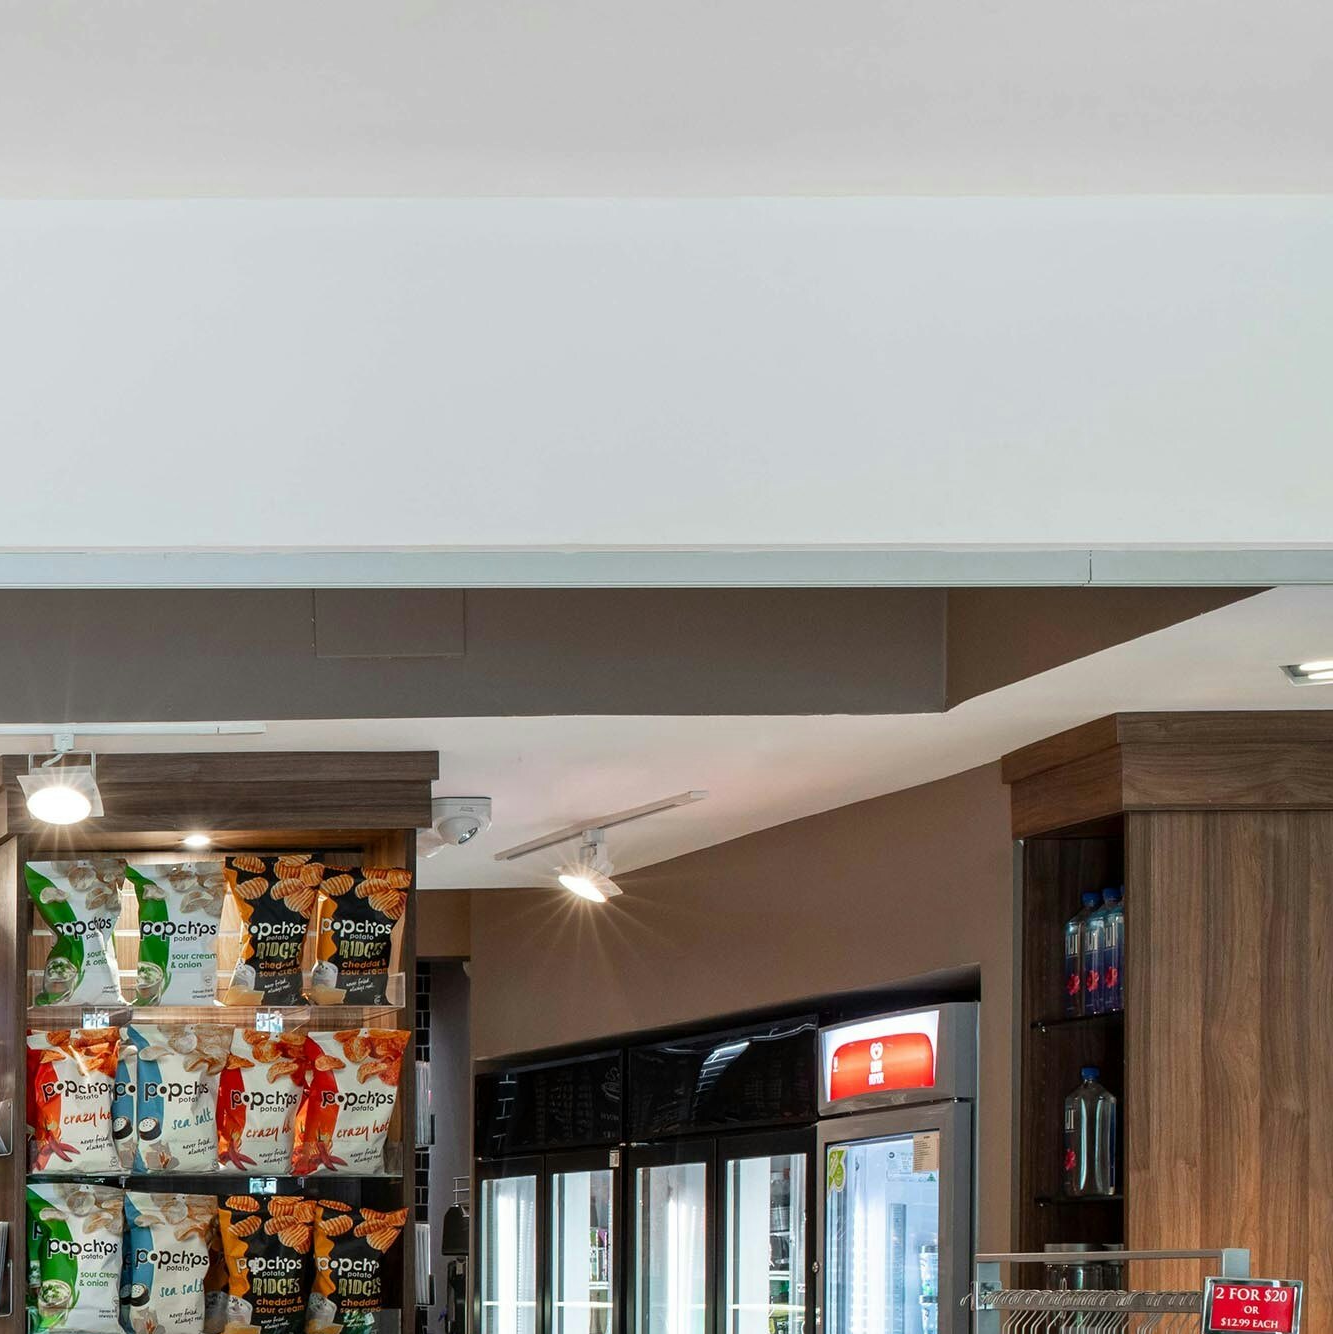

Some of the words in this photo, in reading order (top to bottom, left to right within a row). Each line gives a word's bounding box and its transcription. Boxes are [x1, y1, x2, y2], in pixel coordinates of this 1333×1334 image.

[140, 921, 218, 941] popchips
[321, 918, 392, 937] popchips
[342, 960, 380, 968] cheddar
[231, 1091, 297, 1110] popchips
[321, 1091, 394, 1110] popchips
[63, 1111, 97, 1128] crazy
[172, 1120, 191, 1130] sea
[194, 1108, 214, 1126] salt
[246, 1126, 279, 1142] crazy
[337, 1126, 369, 1142] crazy
[373, 1119, 390, 1132] hot
[47, 1238, 118, 1259] popchips
[135, 1249, 209, 1270] popchips
[159, 1286, 177, 1298] sea
[181, 1278, 203, 1294] salt
[252, 1278, 301, 1296] RIDGES
[1216, 1287, 1225, 1299] 2
[1229, 1288, 1261, 1300] FOR
[1264, 1289, 1287, 1302] $20
[255, 1305, 276, 1314] sour
[278, 1305, 305, 1314] cream
[256, 1298, 295, 1306] cheddar
[1243, 1306, 1259, 1314] OR
[1221, 1317, 1250, 1327] $12.99
[1253, 1320, 1279, 1328] EACH
